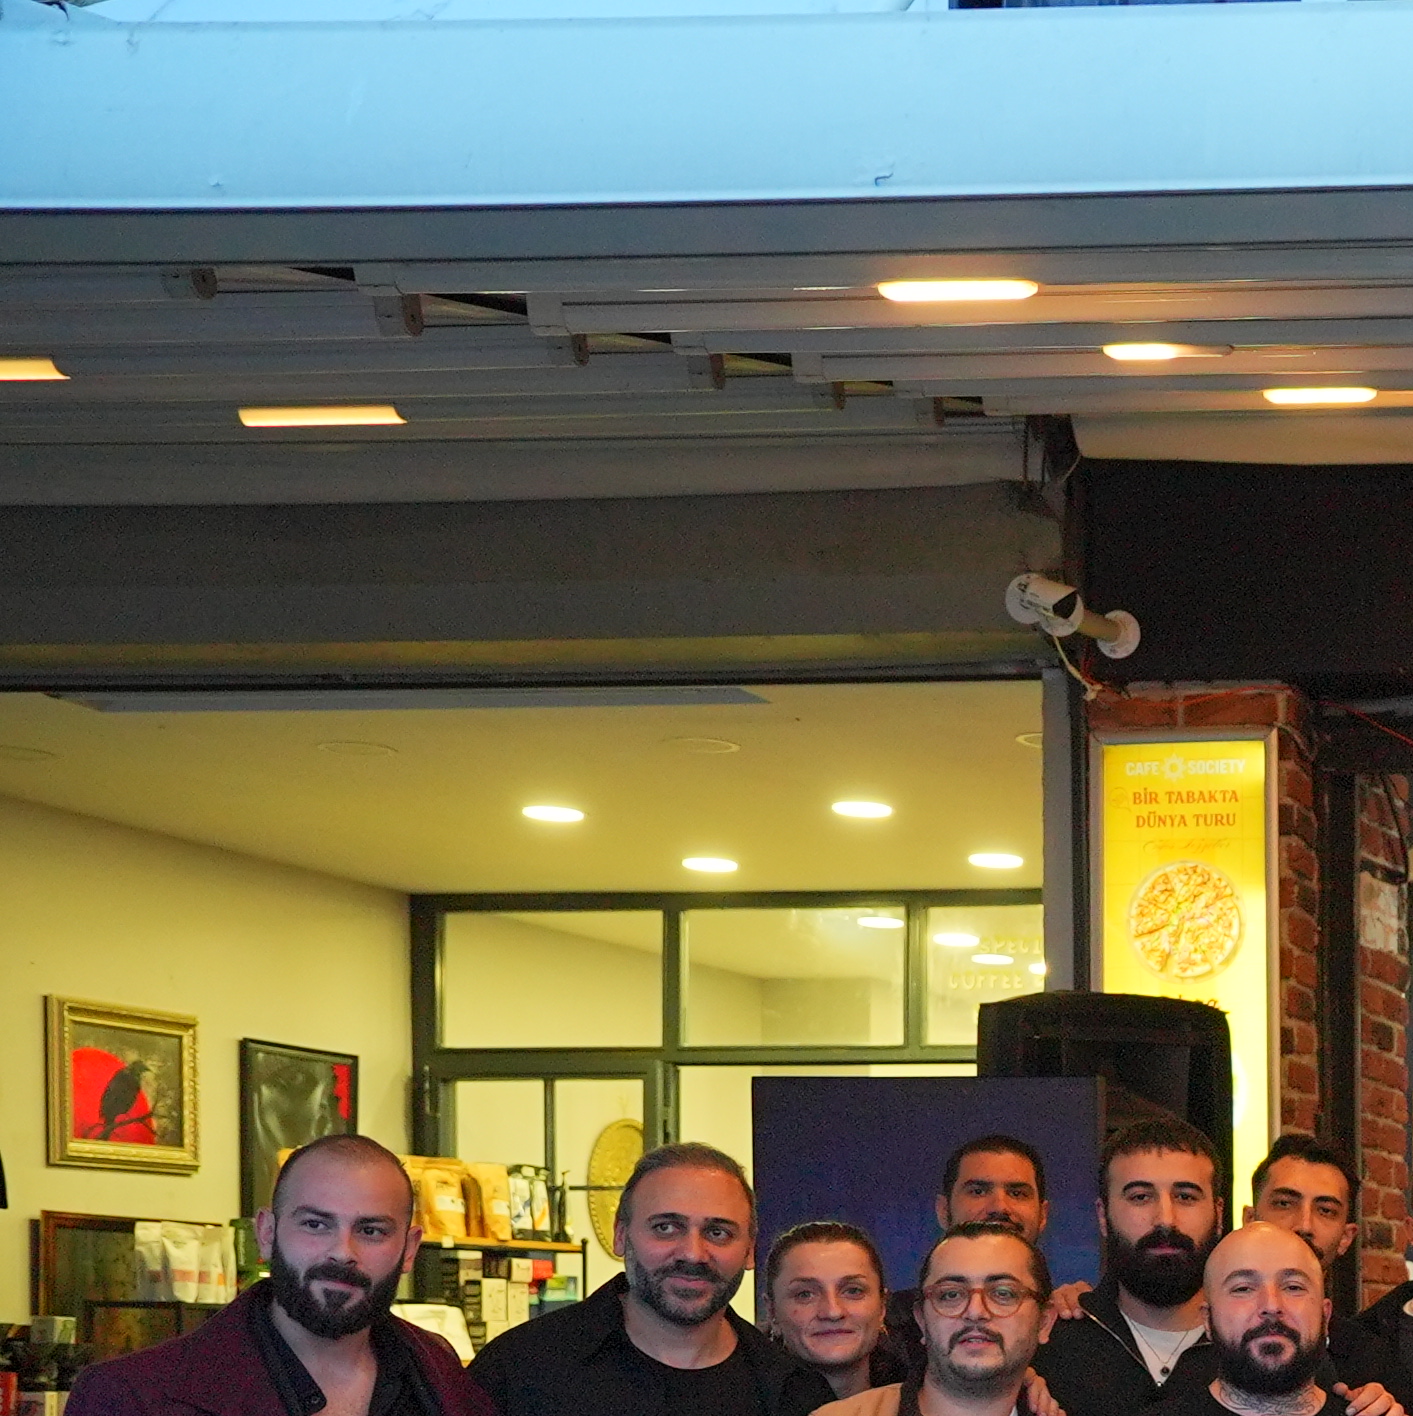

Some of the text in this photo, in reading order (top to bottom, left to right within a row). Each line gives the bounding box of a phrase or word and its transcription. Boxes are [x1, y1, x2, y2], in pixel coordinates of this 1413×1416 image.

[1125, 758, 1246, 776] CAFE SOCIETY
[1133, 788, 1240, 805] BİR TABAKTA
[1136, 811, 1237, 828] DÜNYA TURU
